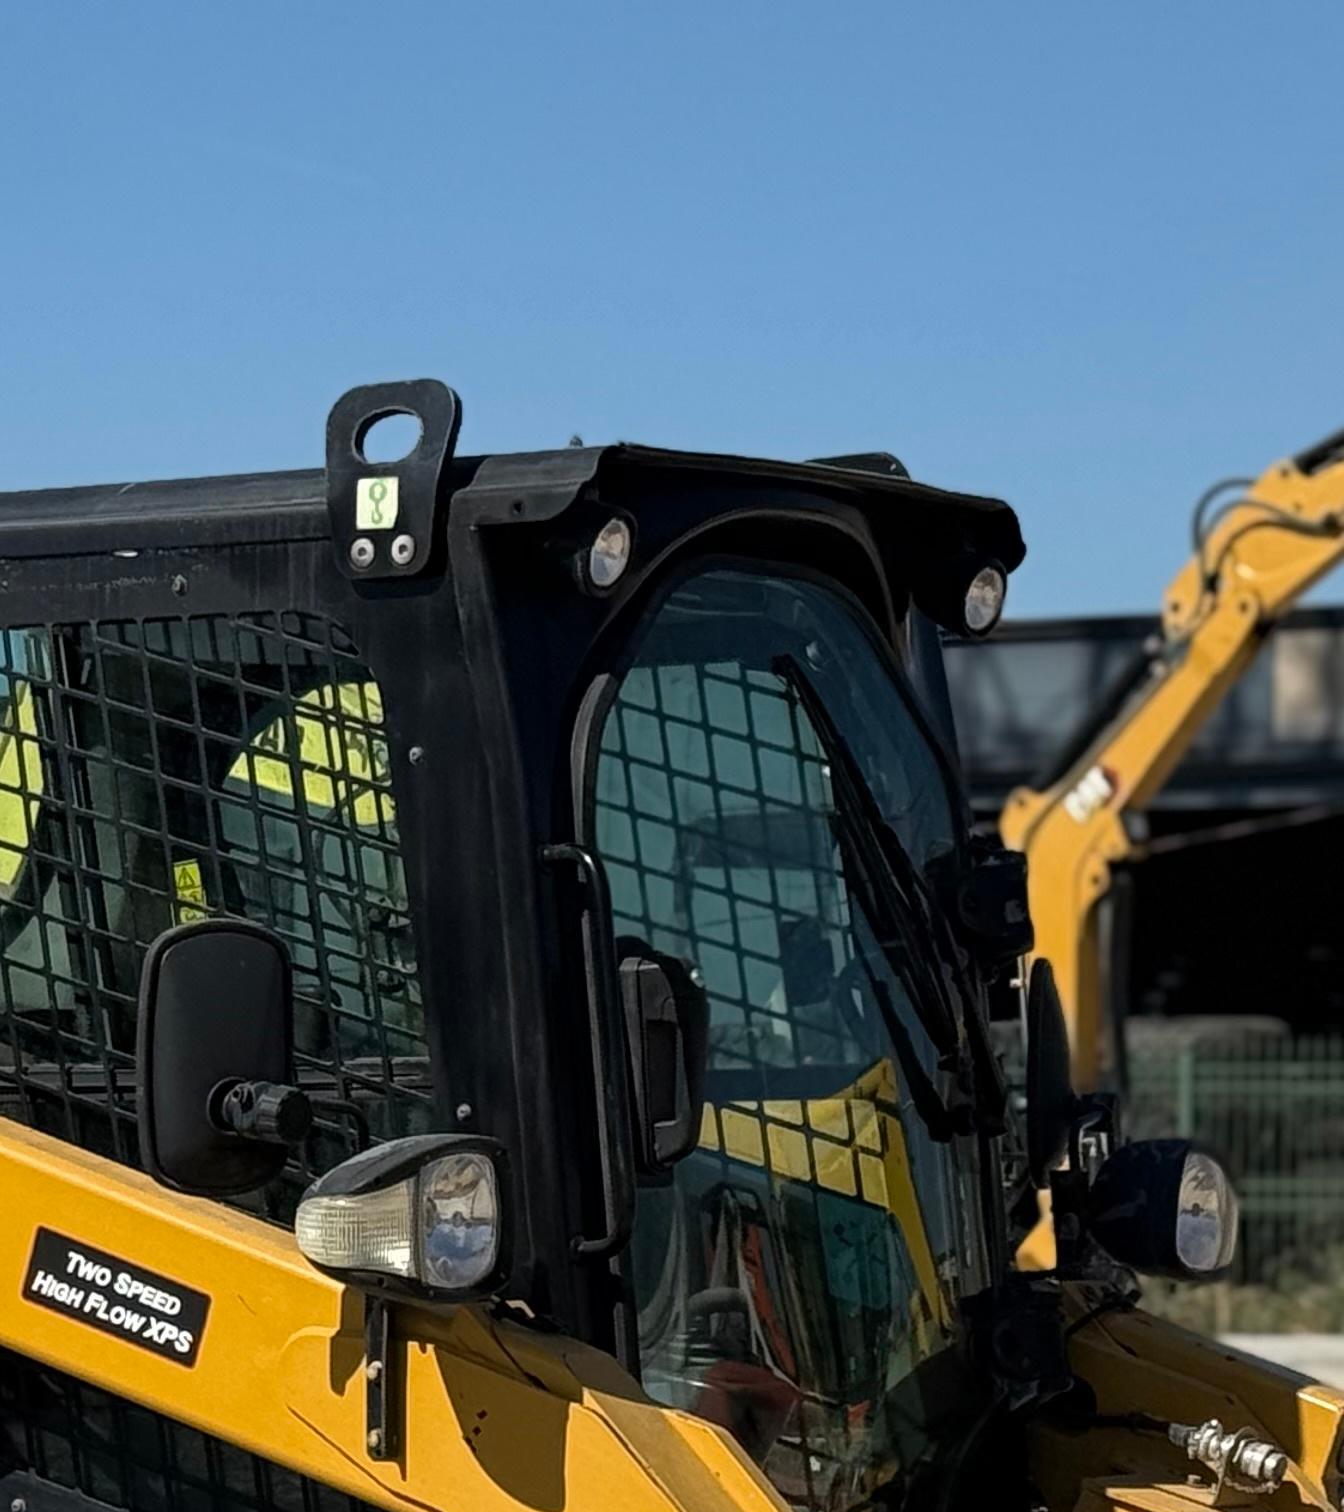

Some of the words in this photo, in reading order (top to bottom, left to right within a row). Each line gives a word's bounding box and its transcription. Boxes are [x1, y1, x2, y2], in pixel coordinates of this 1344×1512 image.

[31, 1270, 85, 1309] HIGH
[82, 1292, 147, 1333] FLOW
[142, 1316, 194, 1354] XPS
[66, 1250, 112, 1286] TWO
[113, 1271, 182, 1315] SPEED
